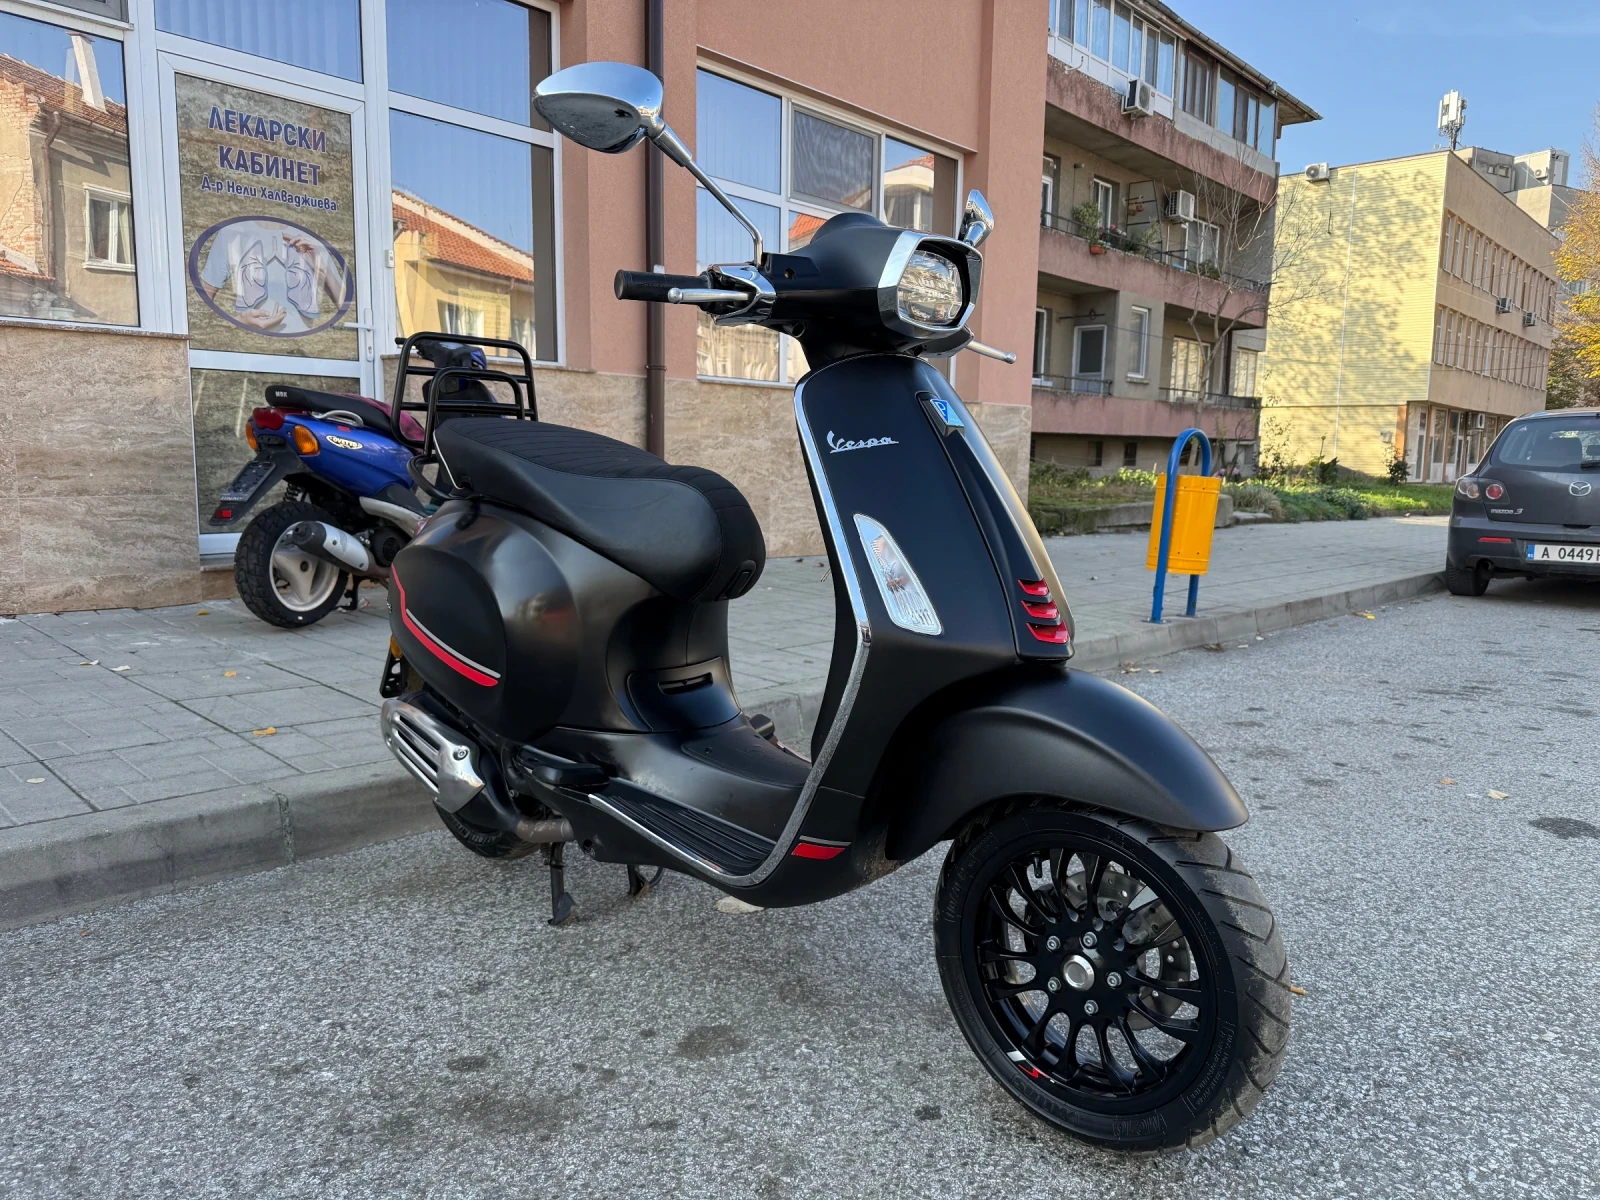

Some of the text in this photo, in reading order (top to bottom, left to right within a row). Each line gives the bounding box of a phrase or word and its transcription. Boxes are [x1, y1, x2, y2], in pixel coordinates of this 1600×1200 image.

[208, 106, 327, 153] ЛЕКАРСКИ
[218, 145, 321, 186] КАБИНЕТ
[201, 176, 337, 211] Д-р Нели Халваджиева
[826, 430, 900, 454] Vespa
[1541, 546, 1550, 559] A
[1558, 547, 1594, 561] 0449
